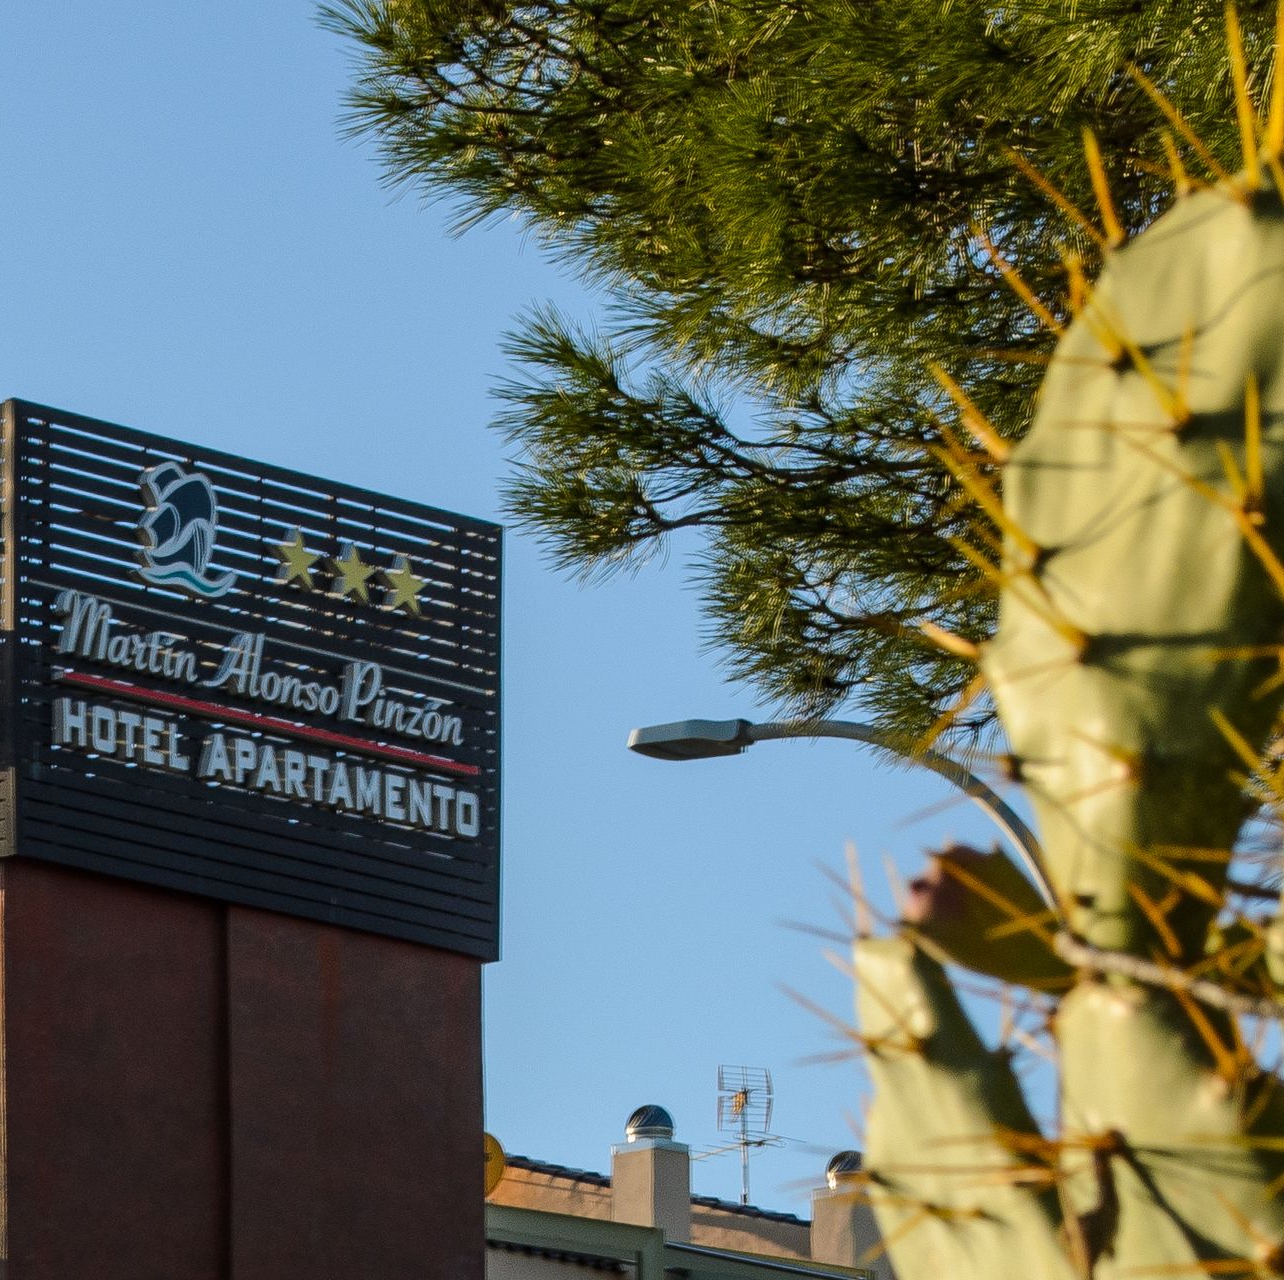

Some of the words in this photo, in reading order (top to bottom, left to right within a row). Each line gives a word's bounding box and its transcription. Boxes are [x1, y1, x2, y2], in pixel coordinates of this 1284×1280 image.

[55, 588, 199, 684] Martín
[198, 631, 340, 716] Alonso
[339, 660, 464, 747] Pinzón
[54, 697, 190, 772] HOTEL
[198, 732, 481, 839] APARTAMENTO
